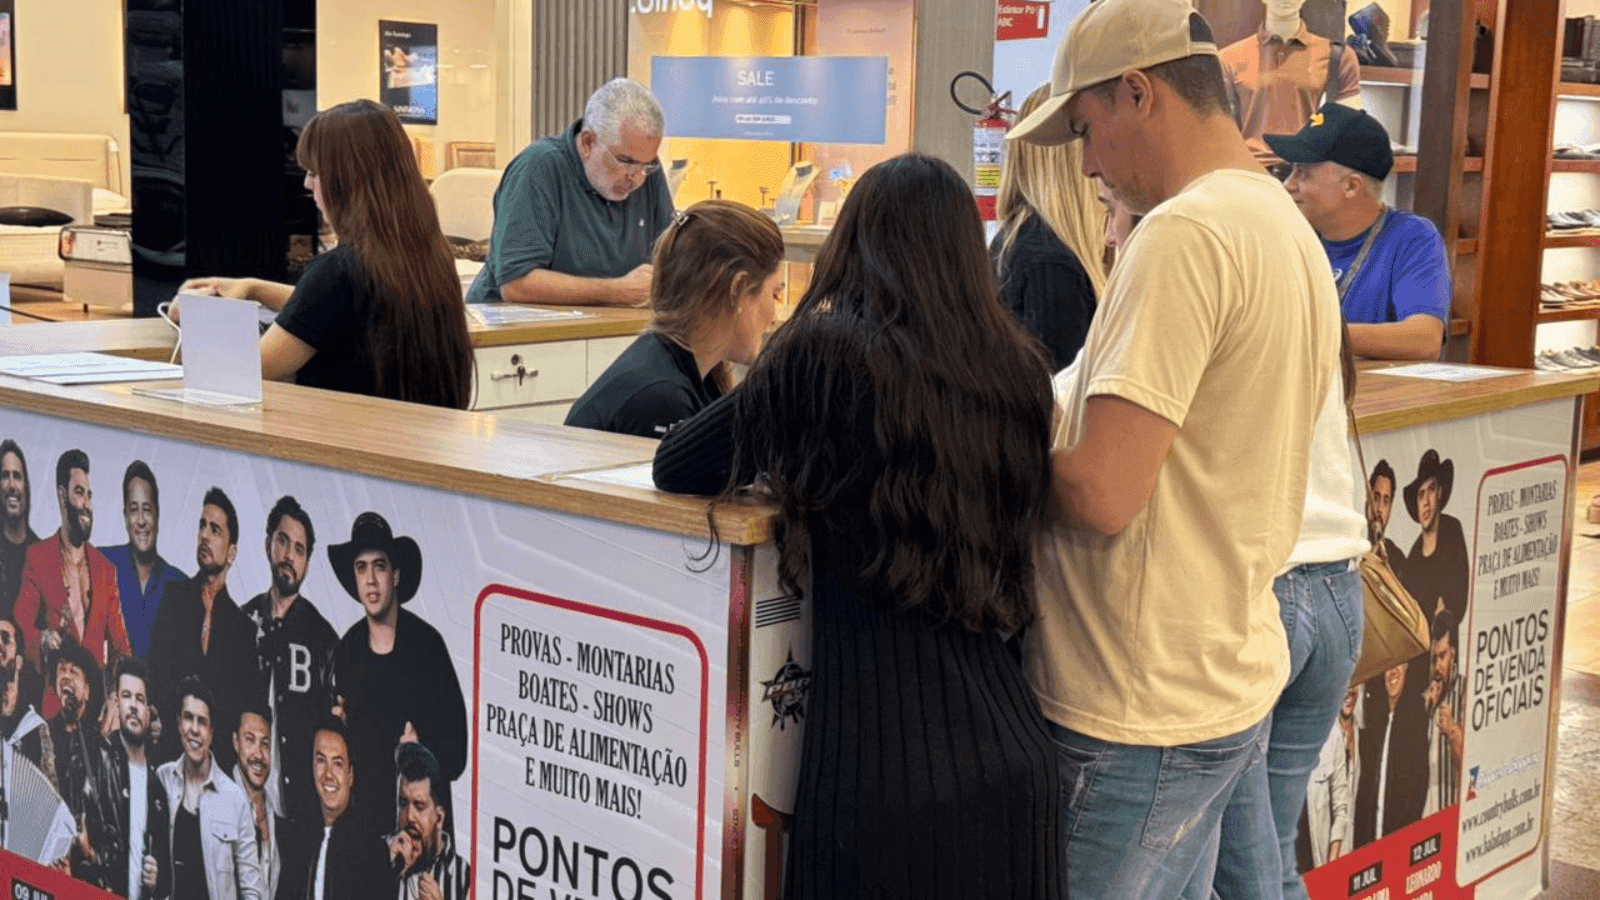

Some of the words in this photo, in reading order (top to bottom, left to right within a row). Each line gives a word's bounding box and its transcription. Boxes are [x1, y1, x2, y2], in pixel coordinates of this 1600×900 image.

[737, 70, 774, 87] SALE
[501, 623, 562, 666] PROVAS
[577, 641, 675, 695] MONTARIAS
[1476, 608, 1549, 665] PONTOS
[288, 643, 311, 693] B
[1474, 663, 1495, 696] DE
[1499, 644, 1545, 685] VENDA
[518, 670, 578, 714] BOATES
[593, 690, 653, 734] SHOWS
[1472, 674, 1544, 731] OFICIAIS
[487, 703, 538, 747] PRAÇA
[543, 719, 565, 753] DE
[569, 727, 687, 788] ALIMENTAÇÃO
[525, 756, 535, 786] E
[539, 760, 590, 803] MUITO
[595, 776, 642, 819] MAIS!
[493, 816, 675, 900] PONTOS
[1423, 837, 1438, 857] JUL
[493, 869, 537, 900] DE
[1405, 860, 1442, 895] LEONARDO
